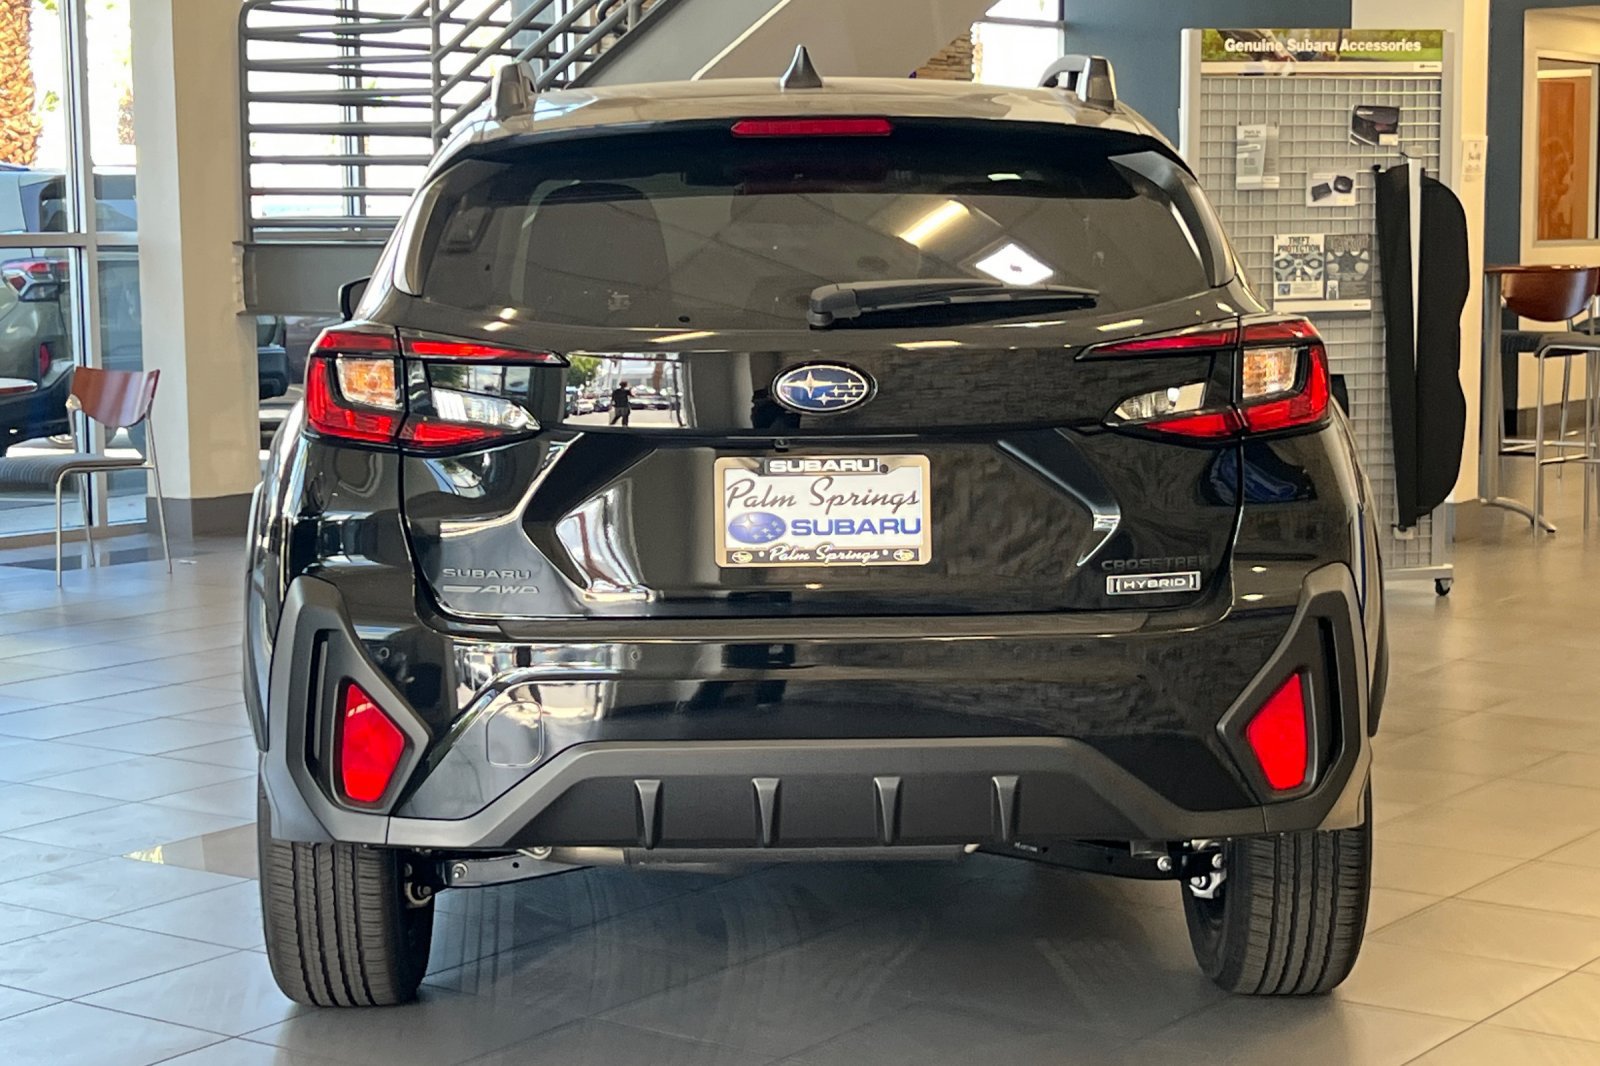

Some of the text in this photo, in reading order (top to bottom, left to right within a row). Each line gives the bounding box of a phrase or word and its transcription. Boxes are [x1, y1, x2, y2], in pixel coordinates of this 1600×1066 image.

[1224, 38, 1422, 52] Genuine Subaru Accessories
[1288, 236, 1310, 245] THEFT
[1278, 245, 1320, 254] PROTECTION
[769, 459, 875, 473] SUBARU
[727, 476, 919, 515] Palm Springs
[791, 518, 921, 536] SUBARU
[769, 545, 880, 564] Palm Springs
[1101, 555, 1210, 571] CROSSTREK
[442, 568, 531, 579] SUBARU
[480, 584, 539, 594] AWD
[1123, 577, 1187, 589] HYBRID
